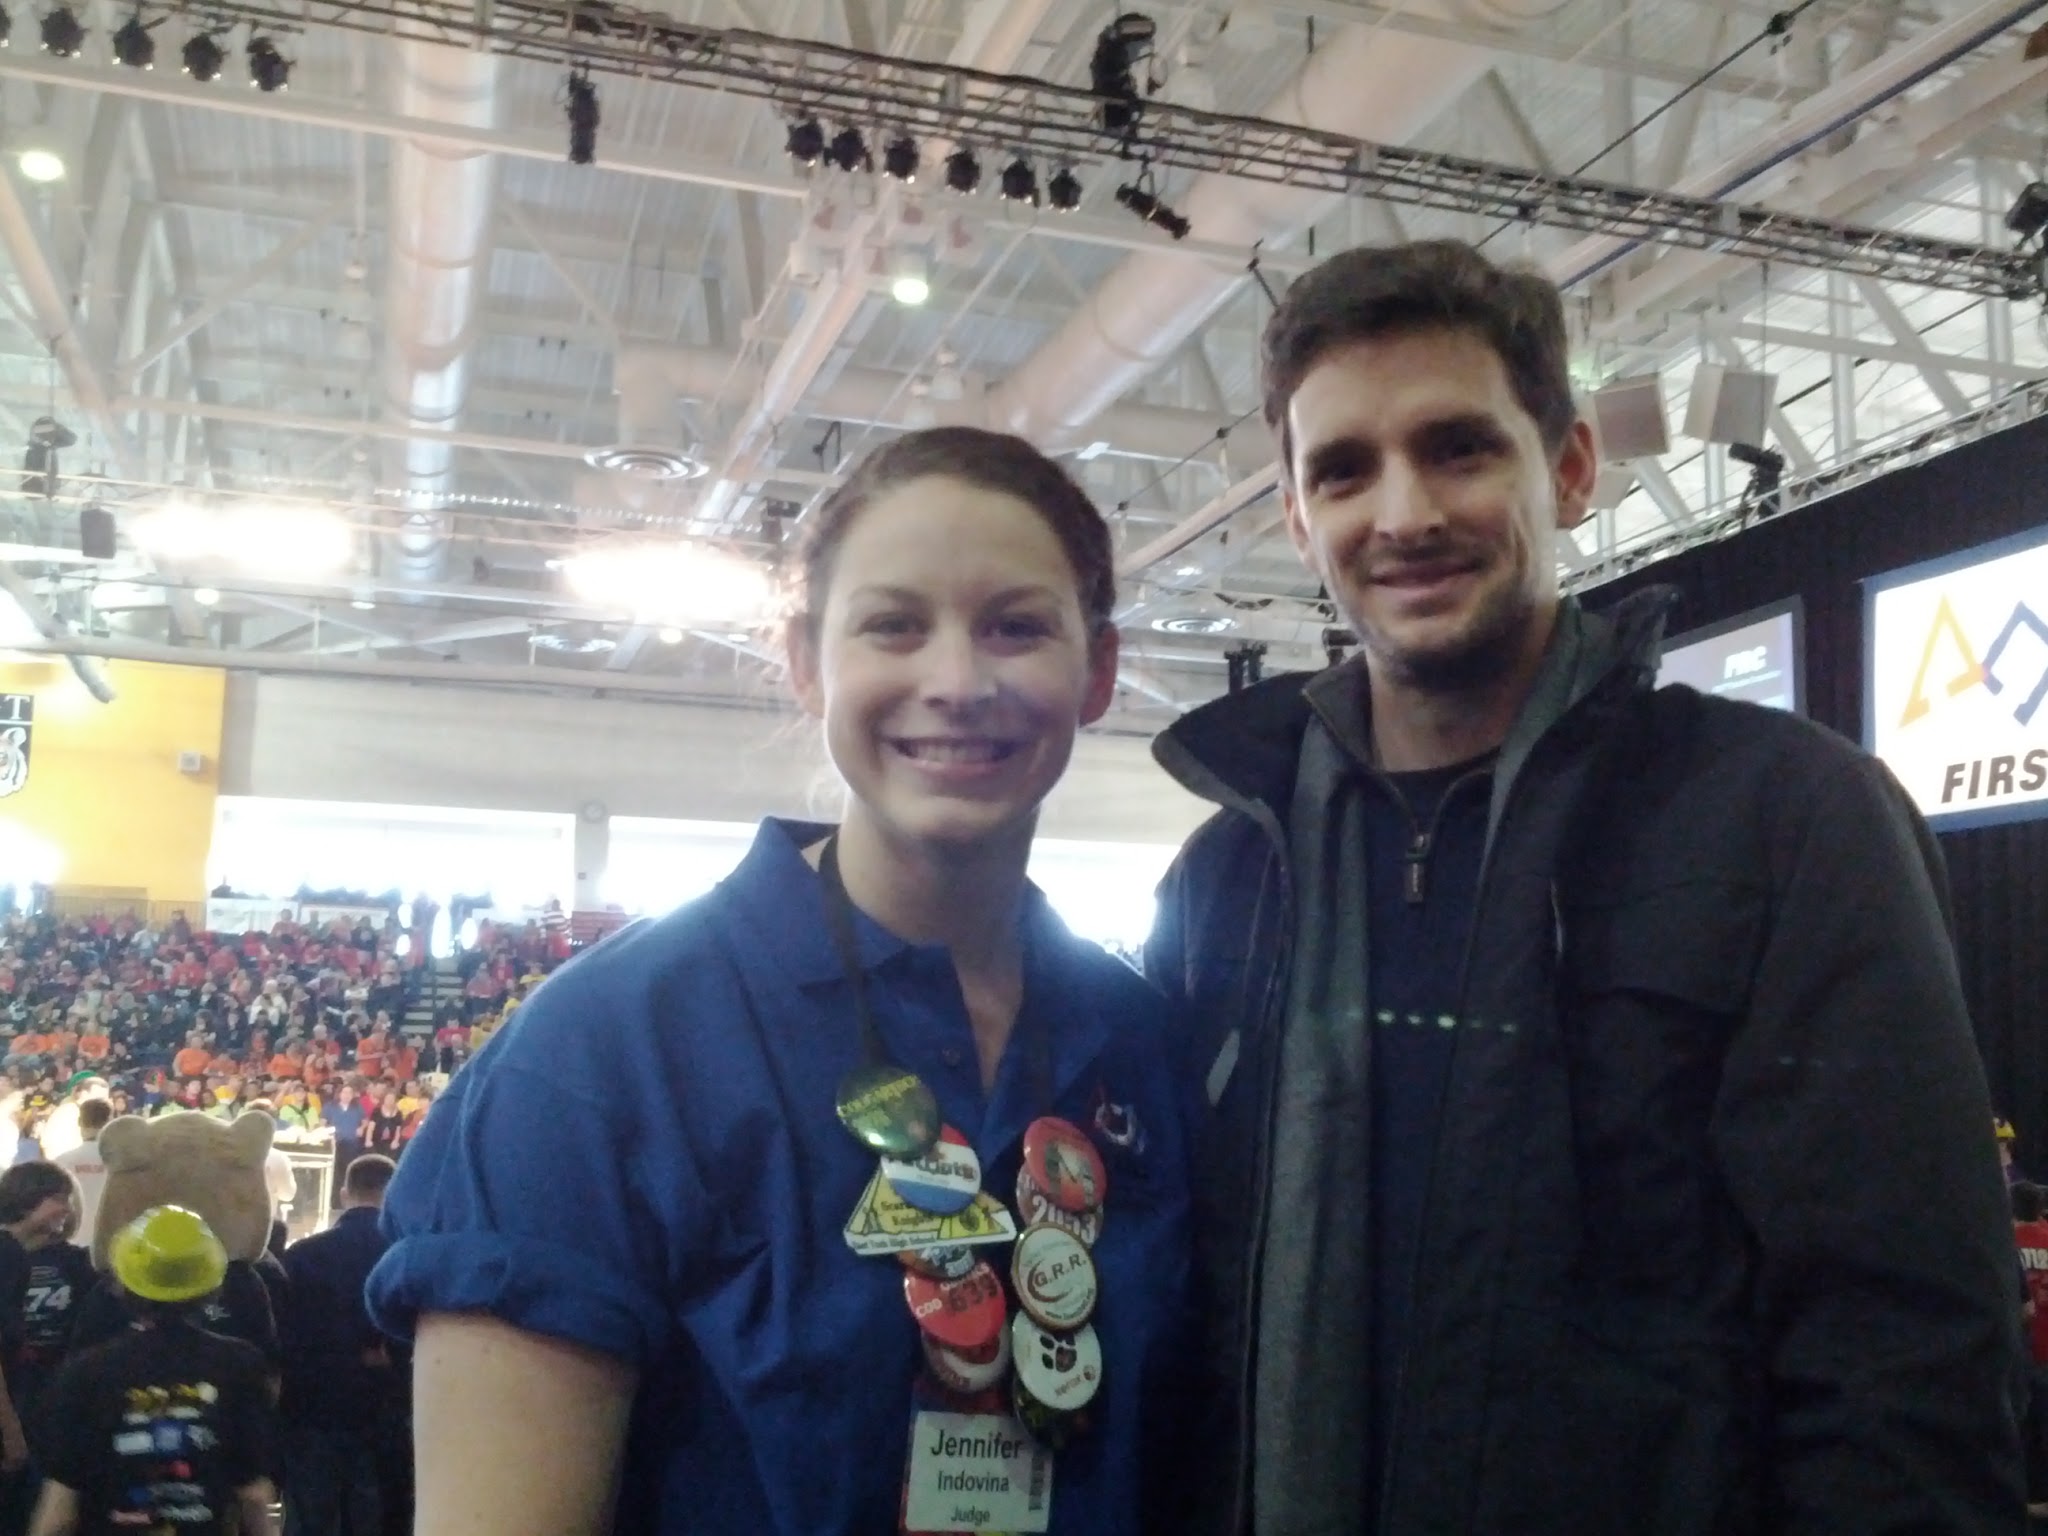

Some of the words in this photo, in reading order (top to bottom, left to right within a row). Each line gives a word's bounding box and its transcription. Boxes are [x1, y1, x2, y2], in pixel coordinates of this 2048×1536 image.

[23, 1285, 72, 1313] 74
[930, 1429, 1023, 1460] Jennifer
[936, 1470, 1010, 1493] Indovina
[950, 1505, 991, 1527] Judge
